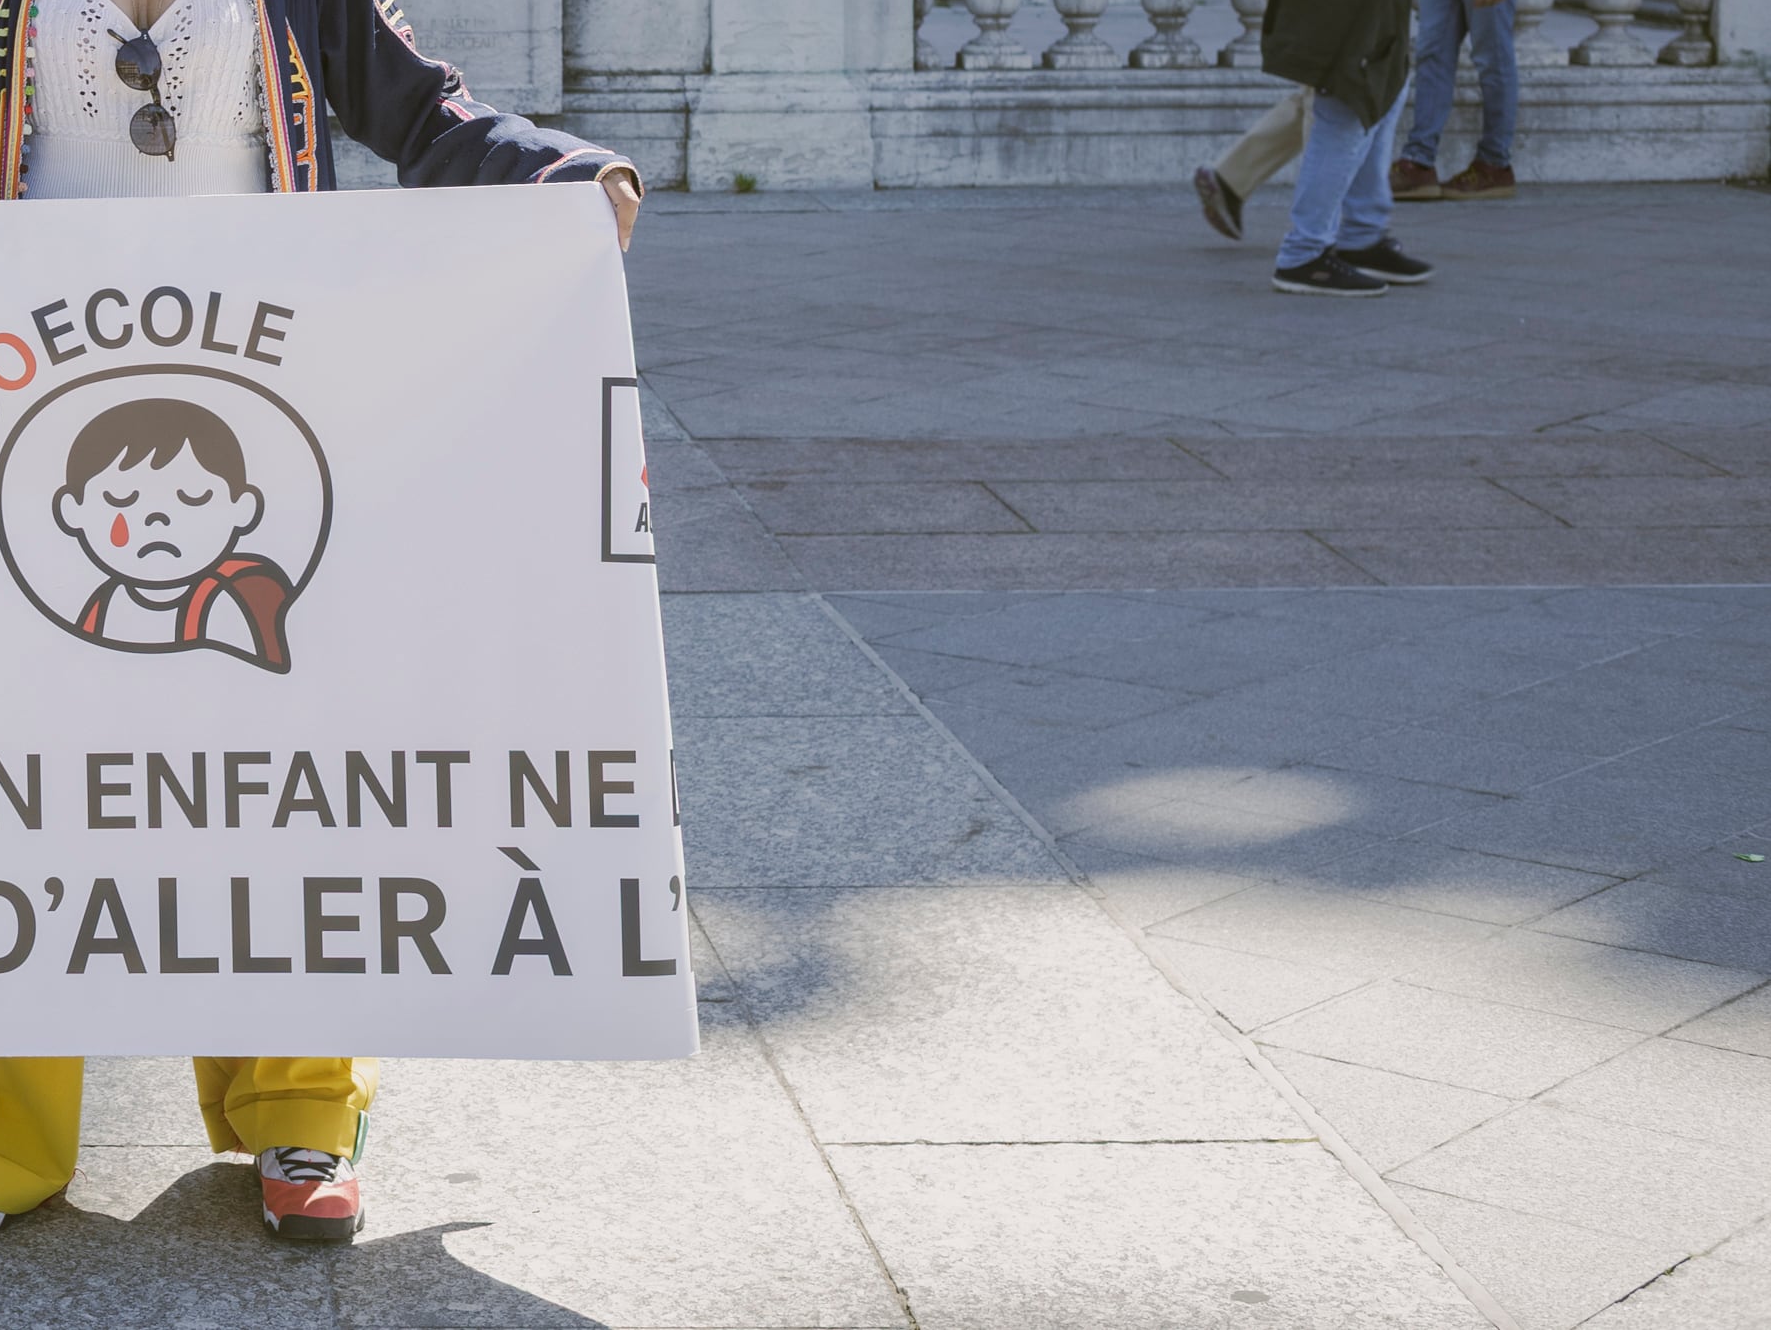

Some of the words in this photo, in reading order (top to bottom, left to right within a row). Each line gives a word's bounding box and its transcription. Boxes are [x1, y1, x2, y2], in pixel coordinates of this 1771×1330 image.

[86, 750, 471, 830] ENFANT
[508, 750, 640, 828] NE
[490, 846, 574, 977] À
